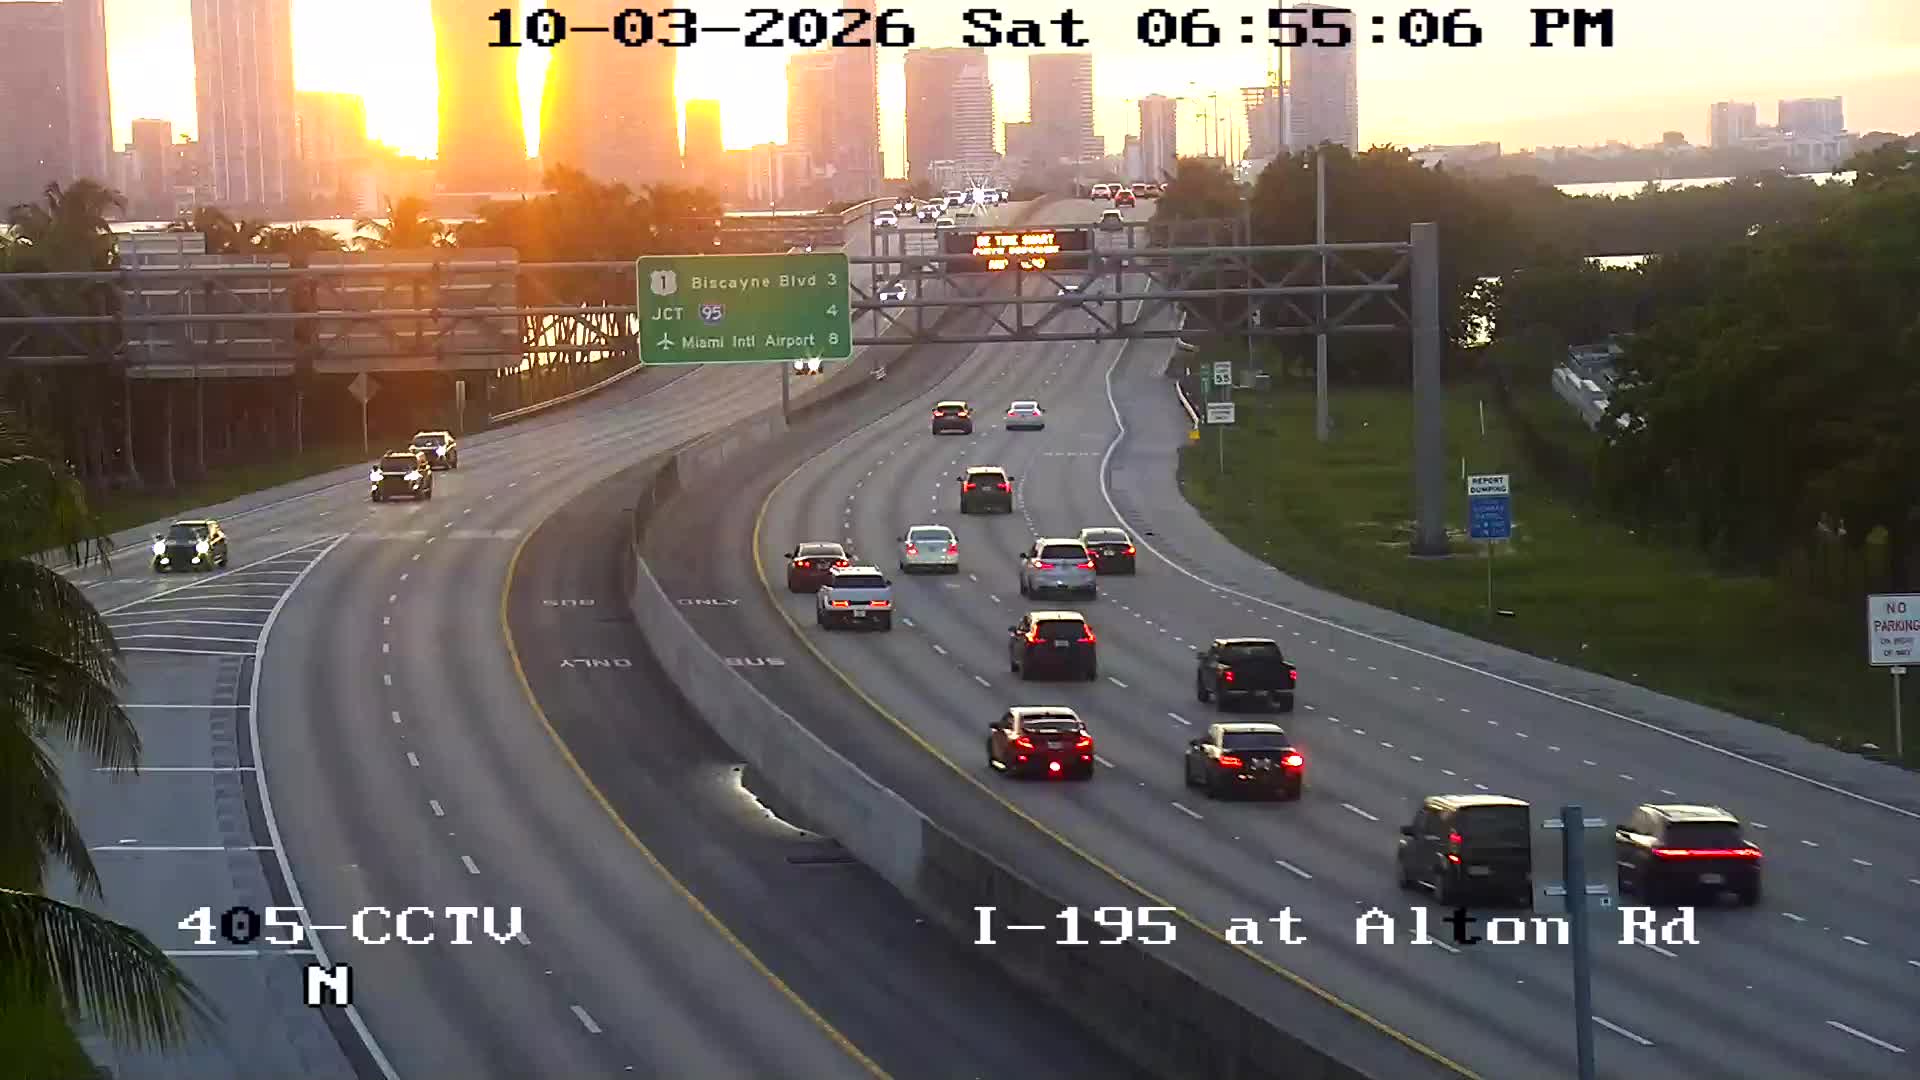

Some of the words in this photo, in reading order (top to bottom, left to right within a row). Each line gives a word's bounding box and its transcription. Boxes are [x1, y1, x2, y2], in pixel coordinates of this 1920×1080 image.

[692, 276, 770, 292] Biscayne
[780, 274, 817, 288] Blvd
[827, 273, 837, 286] 3
[651, 307, 684, 321] JCT
[702, 306, 722, 320] 95
[826, 304, 838, 317] 4
[682, 337, 724, 349] Miami
[732, 335, 755, 348] Intl
[765, 334, 816, 349] Airport
[828, 332, 839, 345] 8
[1472, 477, 1503, 485] REPORT
[1471, 486, 1506, 494] DUMPING
[678, 598, 741, 606] ONLY
[1886, 602, 1906, 614] NO
[1874, 620, 1920, 632] PARKING
[560, 658, 633, 669] ONLY
